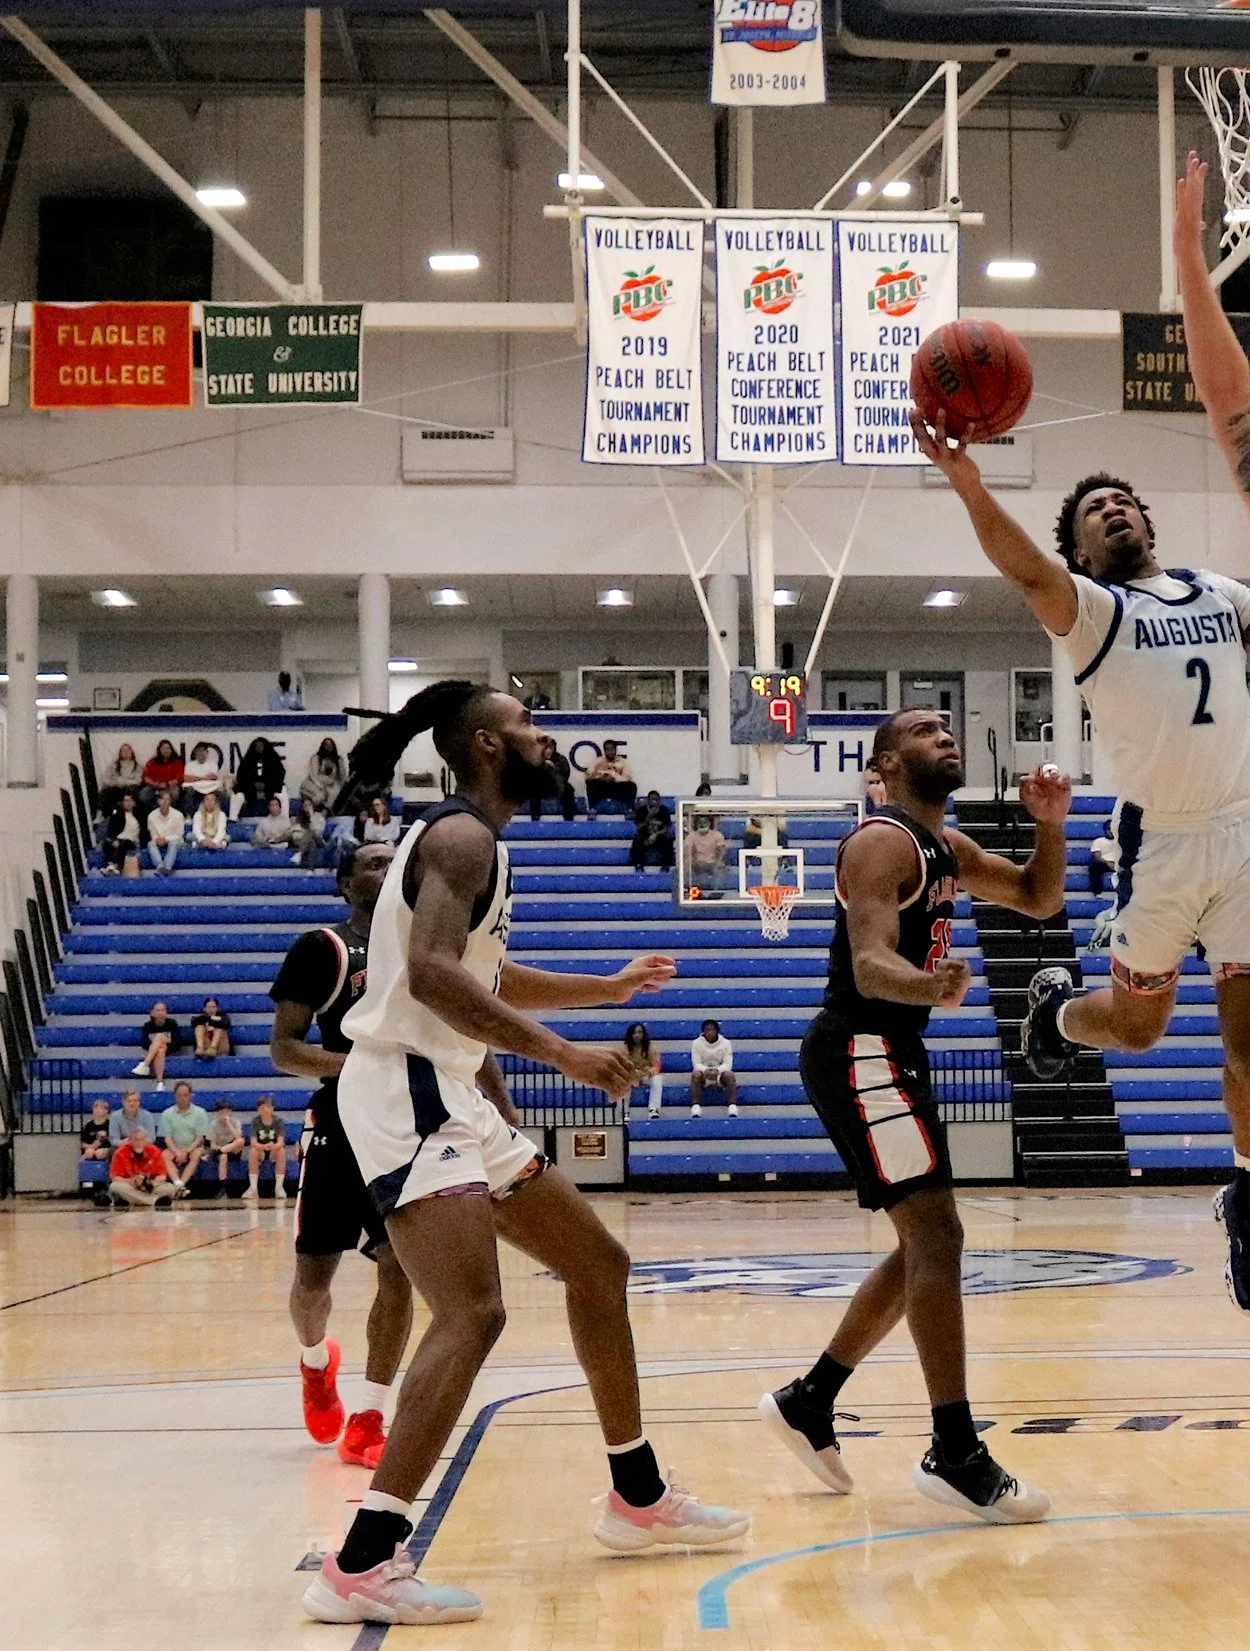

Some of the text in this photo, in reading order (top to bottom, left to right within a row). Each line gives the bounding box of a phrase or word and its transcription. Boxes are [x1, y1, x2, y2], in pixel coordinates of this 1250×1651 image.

[730, 74, 806, 90] 2003-2004
[595, 229, 695, 251] VOLLEYBALL
[725, 230, 825, 251] VOLLEYBALL
[848, 232, 949, 253] VOLLEYBALL
[612, 279, 673, 315] PBC
[743, 272, 804, 310] PBC
[867, 274, 928, 311] PBC
[57, 324, 166, 346] FLAGLER
[205, 314, 358, 338] GEORGIA COLLEGE
[754, 325, 799, 344] 2020
[879, 326, 920, 346] 2021
[273, 346, 293, 363] &
[621, 336, 668, 356] 2019
[728, 351, 825, 372] PEACH BELT
[850, 352, 899, 373] PEACH
[58, 365, 166, 386] COLLEGE
[208, 371, 358, 395] STATE UNIVERSITY
[596, 367, 693, 390] PEACH BELT
[731, 378, 821, 399] CONFERENCE
[854, 379, 911, 400] CONFER
[1125, 380, 1172, 401] STATE
[599, 400, 690, 423] TOURNAMENT
[731, 404, 823, 426] TOURNAMENT
[855, 406, 909, 427] TOURNA
[597, 432, 692, 454] CHAMPIONS
[730, 431, 826, 452] CHAMPIONS
[854, 433, 918, 454] CHAMPI
[1135, 611, 1238, 650] AUGUSTA
[750, 675, 802, 697] 9:19
[1186, 657, 1215, 727] 2
[768, 697, 795, 737] 9
[807, 740, 863, 773] TH
